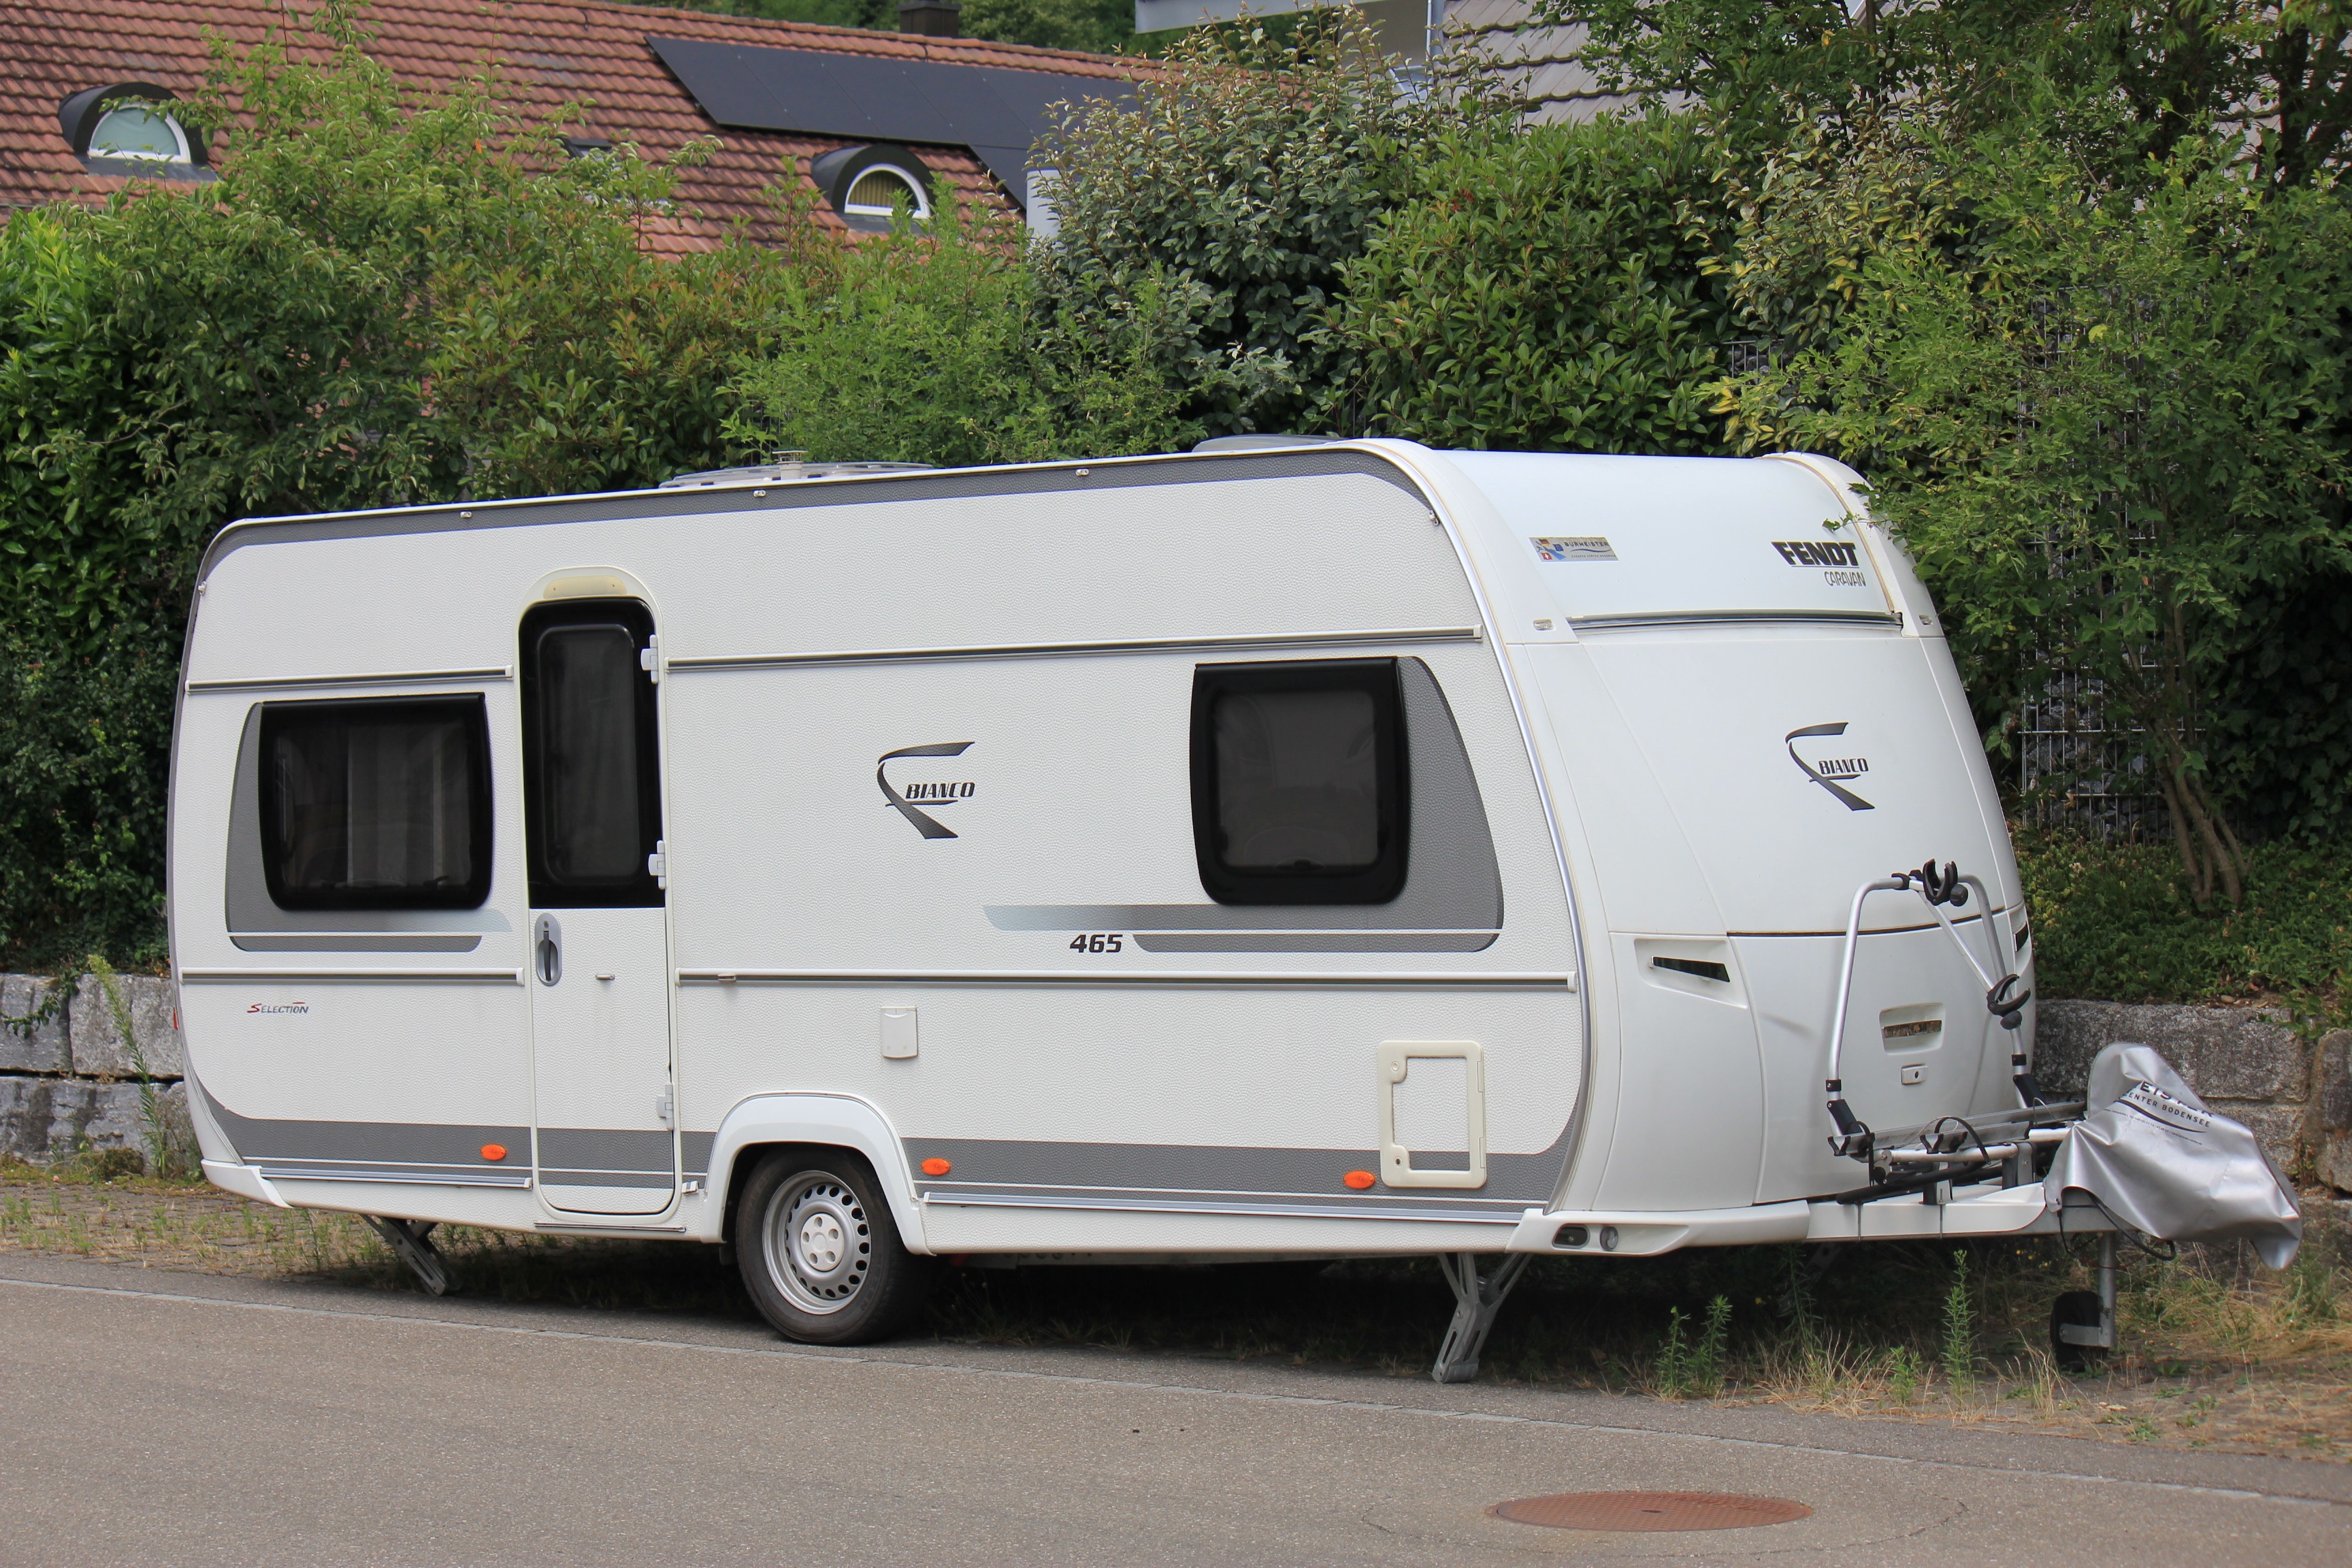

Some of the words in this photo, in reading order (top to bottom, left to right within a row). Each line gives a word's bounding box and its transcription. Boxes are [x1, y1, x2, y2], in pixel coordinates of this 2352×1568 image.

[1771, 541, 1859, 566] FENDT
[1824, 571, 1867, 587] CARAVAN
[1818, 758, 1869, 774] BIANCO
[905, 782, 975, 799] BIANCO
[1069, 934, 1124, 953] 465
[246, 1001, 309, 1014] SELECTION
[2122, 1091, 2158, 1107] ENTER
[2161, 1103, 2211, 1128] BODENSEE
